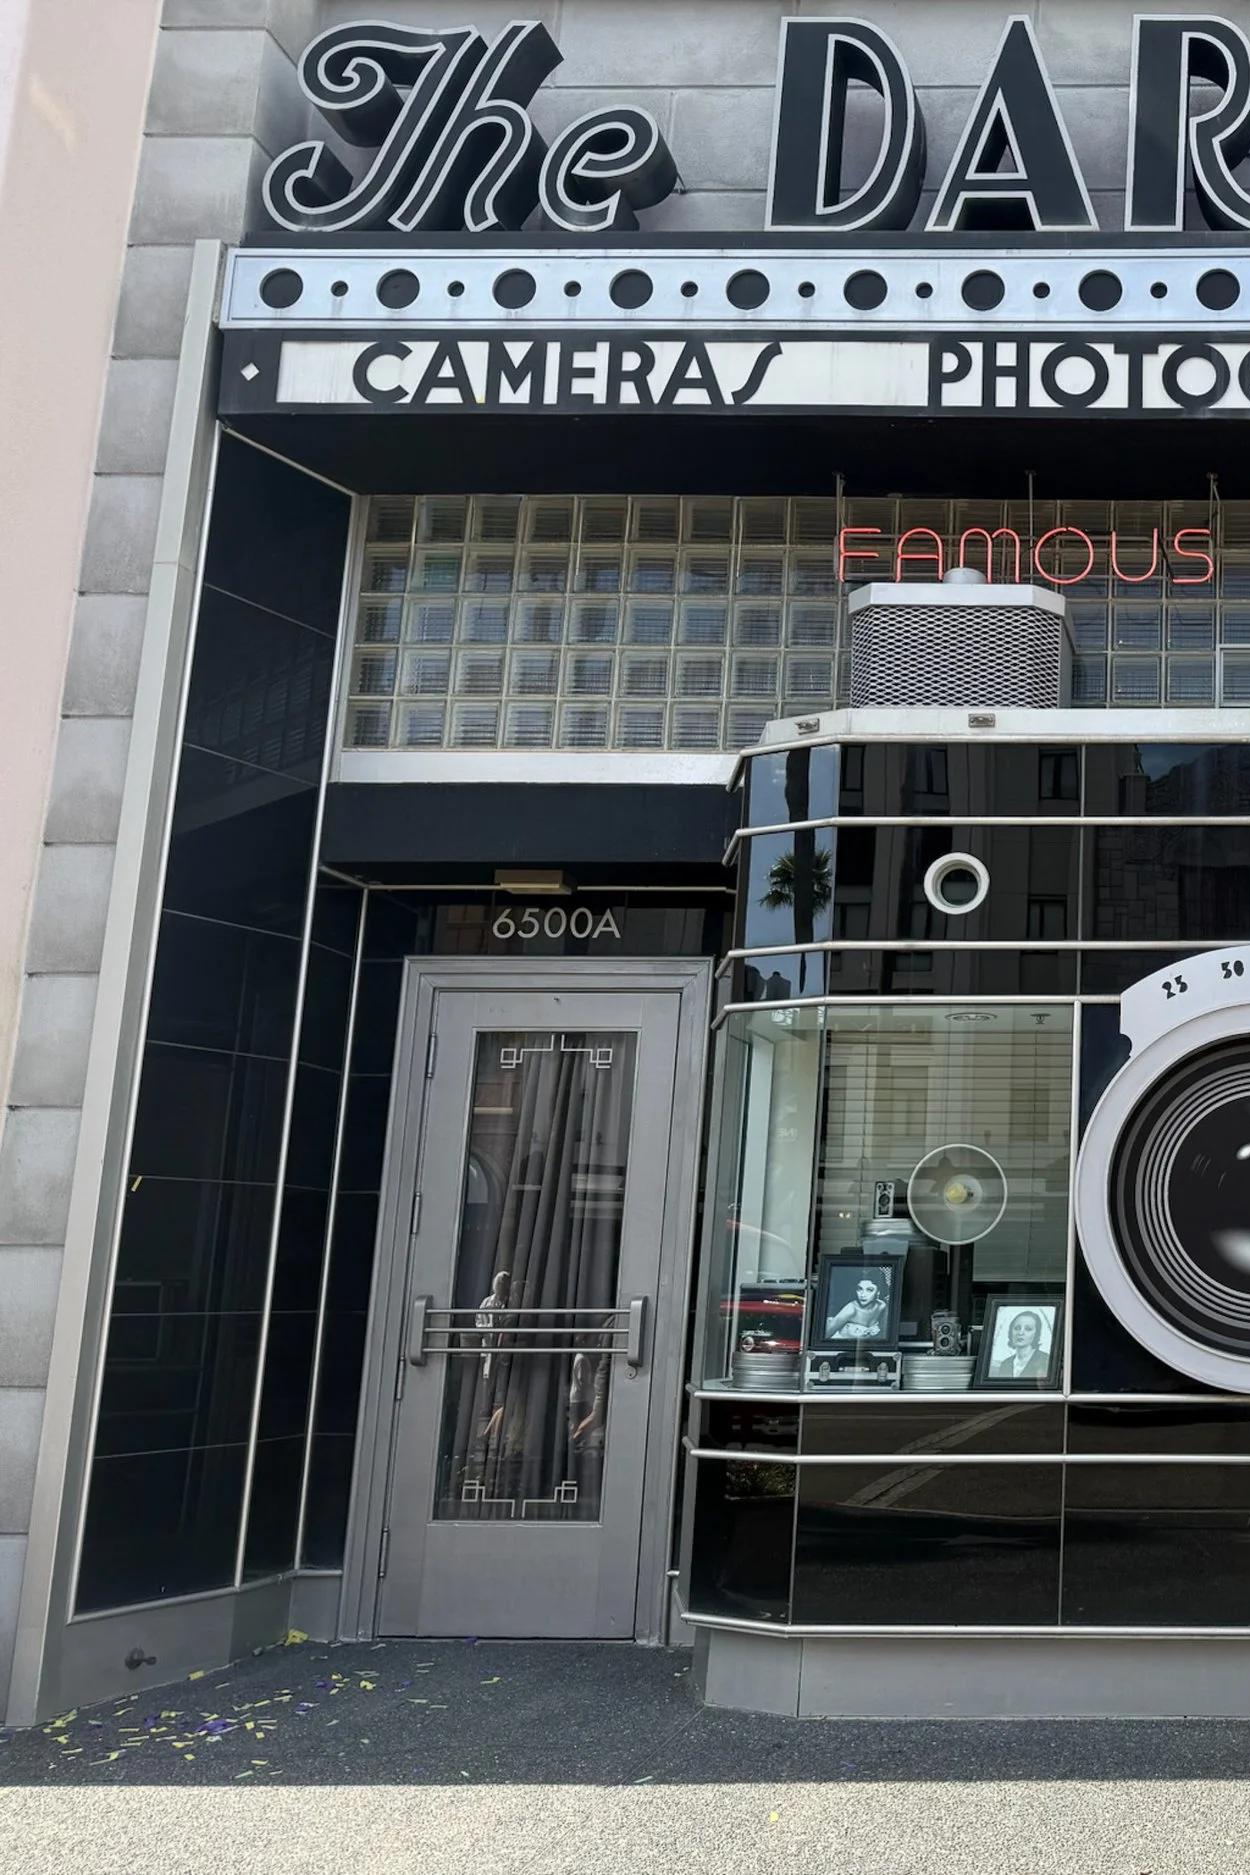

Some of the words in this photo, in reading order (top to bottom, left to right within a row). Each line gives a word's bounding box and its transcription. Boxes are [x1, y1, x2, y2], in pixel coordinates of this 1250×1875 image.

[262, 19, 668, 232] The
[352, 341, 784, 404] CAMERAS
[837, 526, 1215, 585] FAMOUS
[492, 907, 621, 939] 6500A
[1221, 959, 1245, 979] 50
